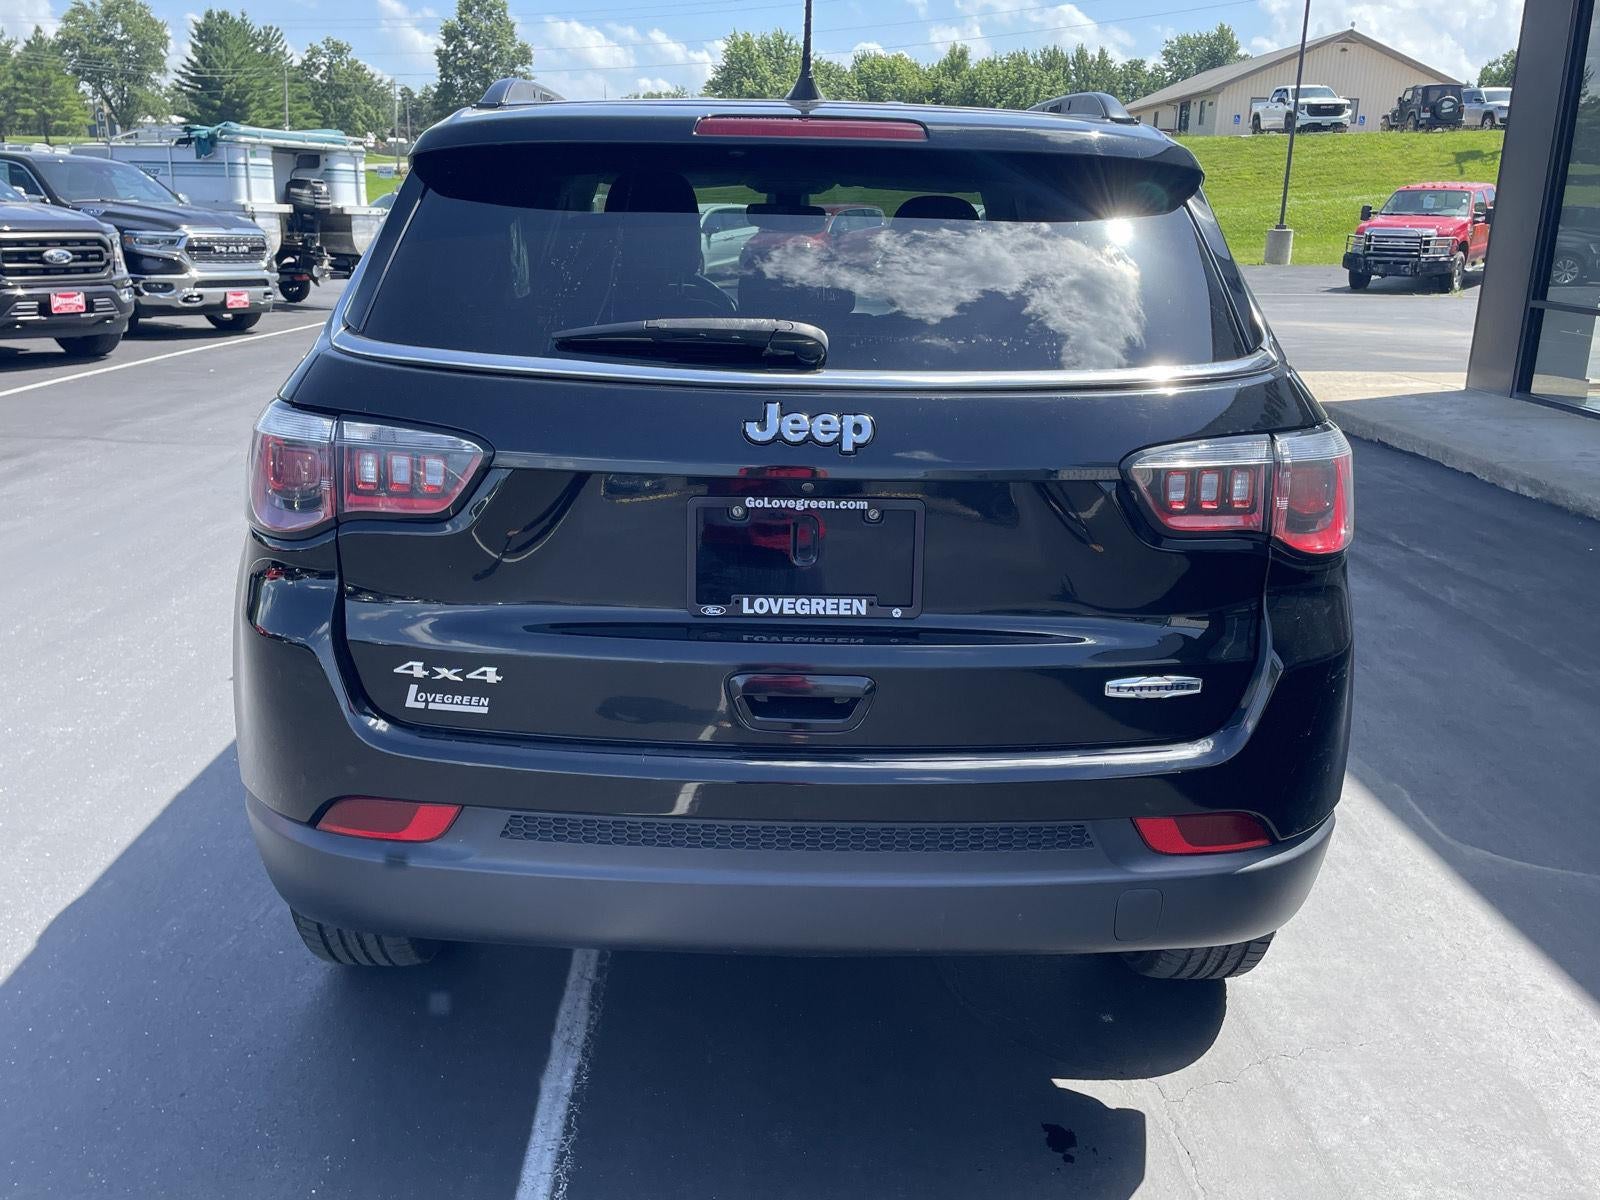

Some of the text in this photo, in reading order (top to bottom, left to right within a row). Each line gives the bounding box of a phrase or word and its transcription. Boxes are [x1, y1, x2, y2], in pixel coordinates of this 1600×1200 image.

[213, 245, 250, 254] RAM
[744, 402, 875, 453] Jeep
[744, 497, 869, 511] GoLovegreen.com
[703, 605, 724, 614] Ford
[742, 597, 867, 616] LOVEGREEN
[393, 661, 503, 684] 4x4
